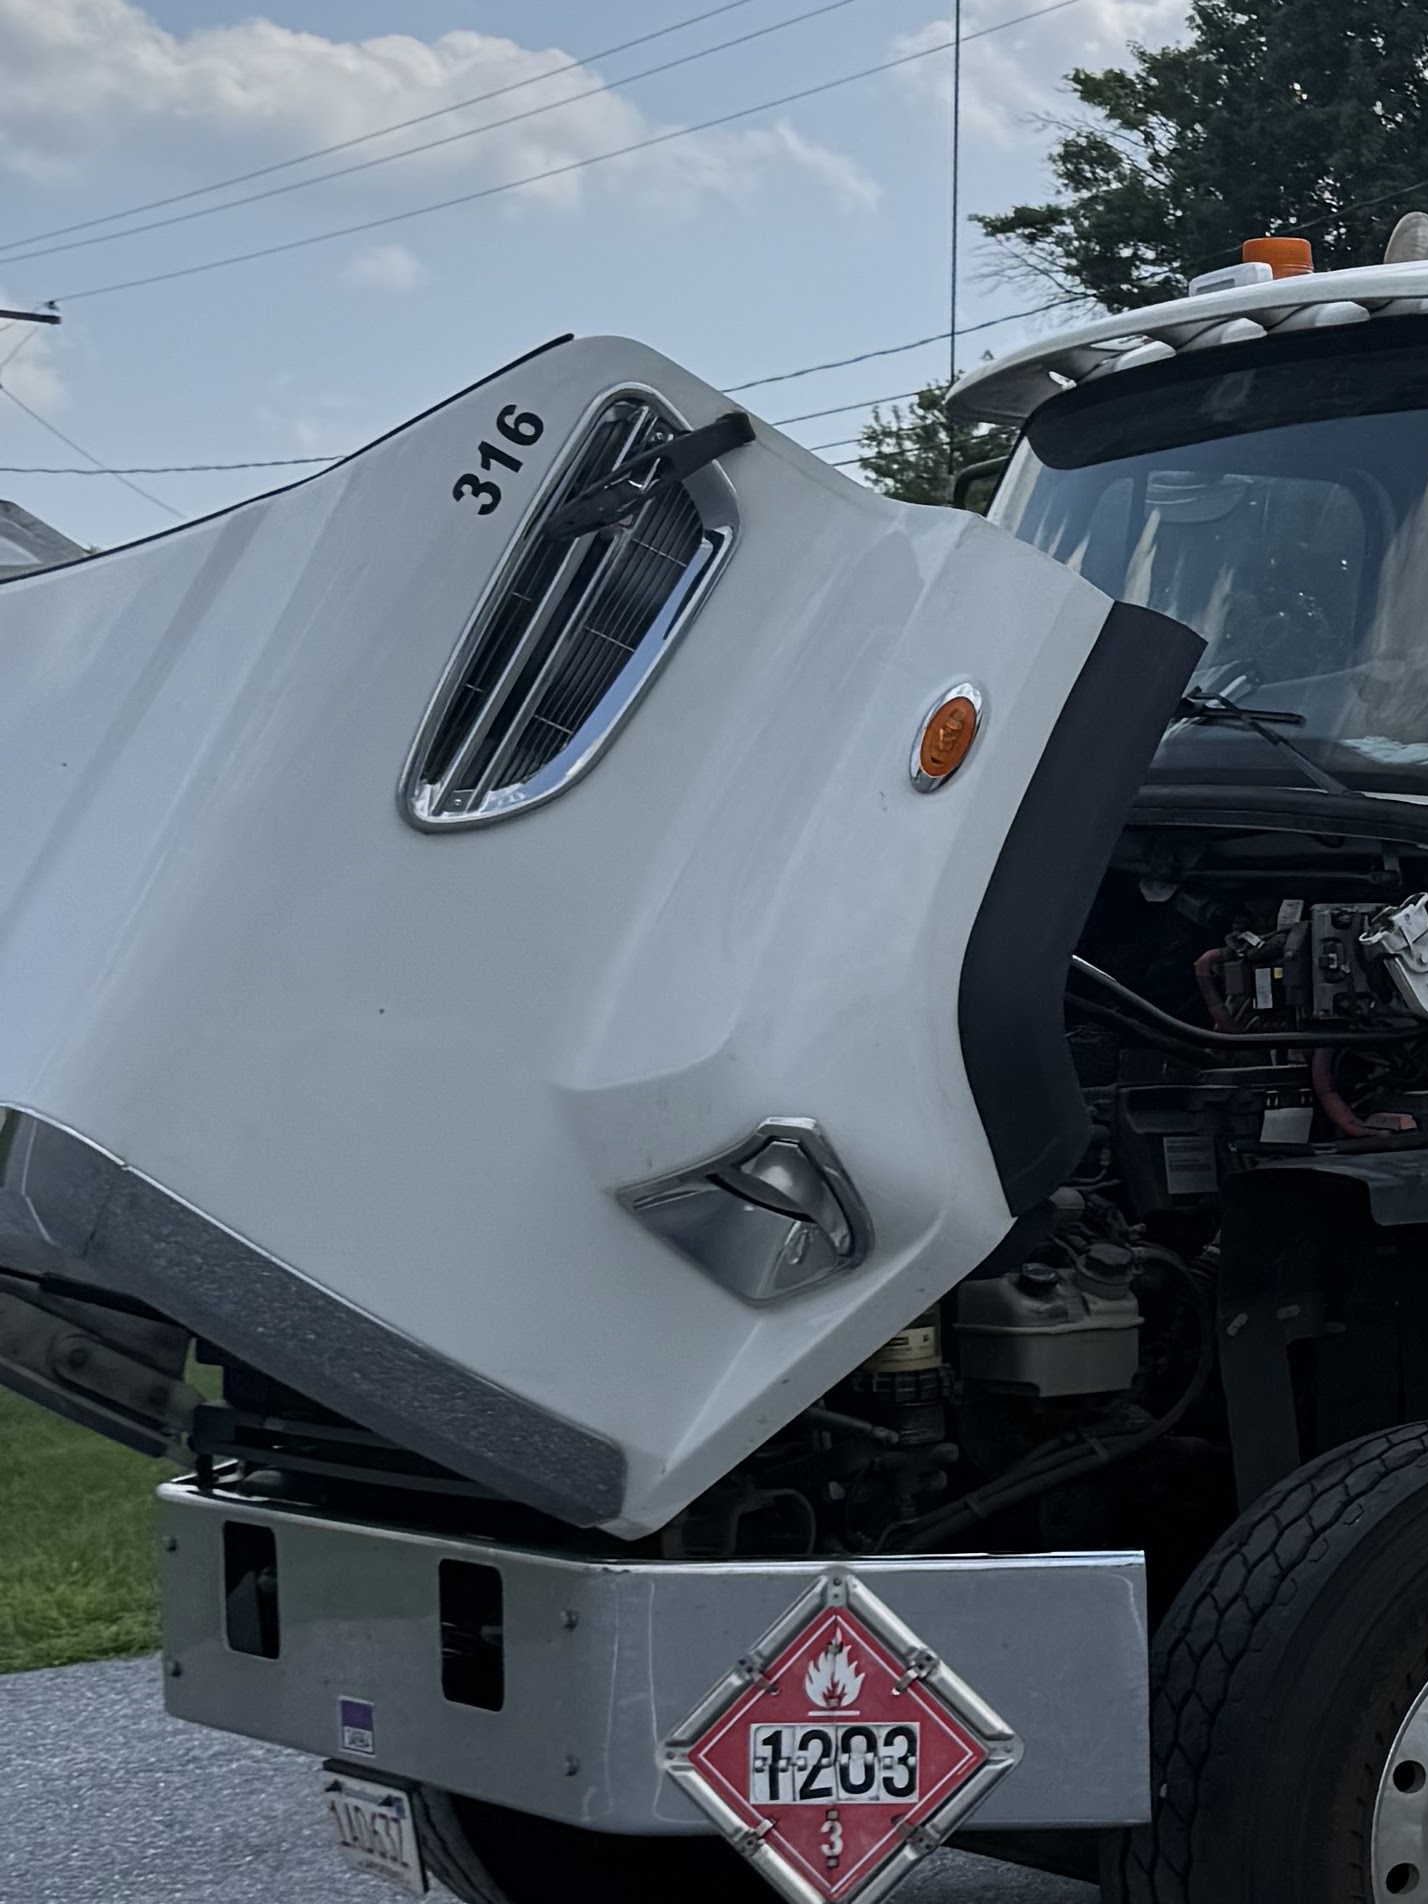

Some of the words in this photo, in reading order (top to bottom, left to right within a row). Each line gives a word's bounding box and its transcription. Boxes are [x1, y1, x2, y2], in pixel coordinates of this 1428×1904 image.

[453, 404, 545, 515] 316
[762, 1726, 917, 1800] 1203
[820, 1820, 844, 1857] 3
